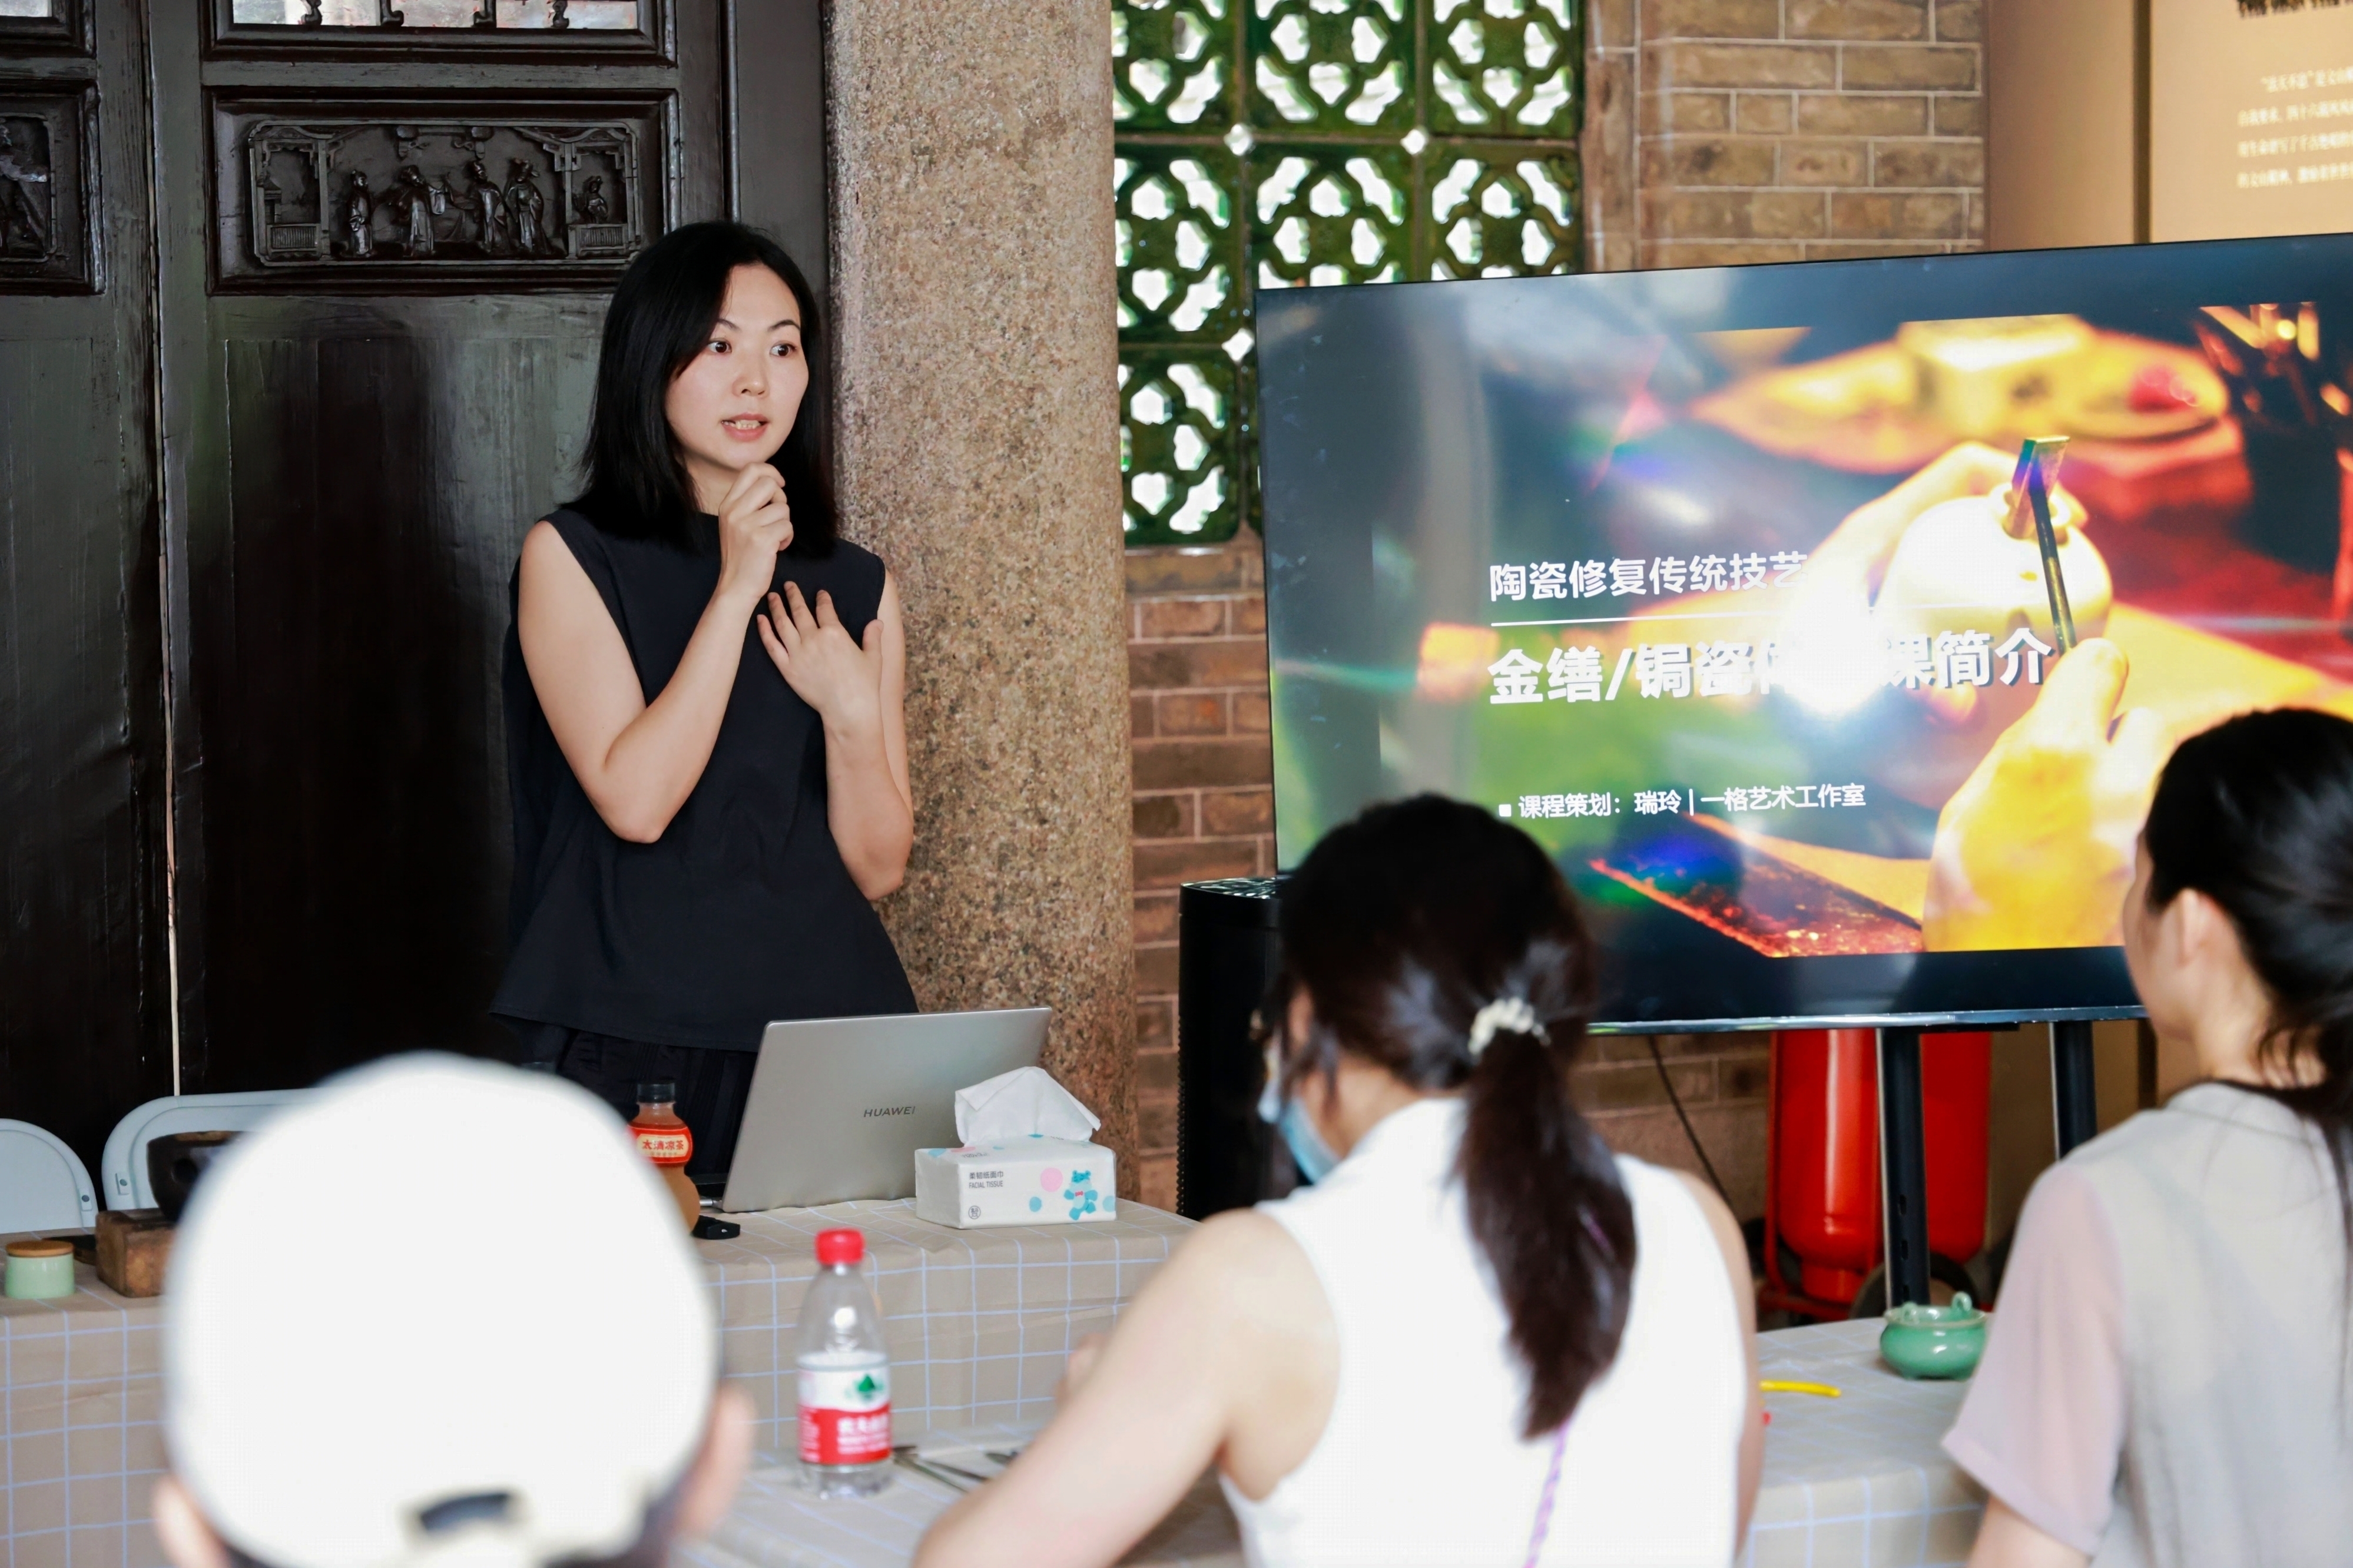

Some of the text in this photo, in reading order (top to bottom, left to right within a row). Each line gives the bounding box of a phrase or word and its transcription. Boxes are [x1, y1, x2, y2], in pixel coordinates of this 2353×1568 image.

[1490, 551, 1808, 602] 陶瓷修复传统技艺
[1487, 627, 2053, 705] 金缮/锔瓷课简介
[863, 1106, 916, 1118] HUAWEI
[969, 1170, 1004, 1180] 柔韧纸面巾
[986, 1180, 1003, 1188] TISSUE
